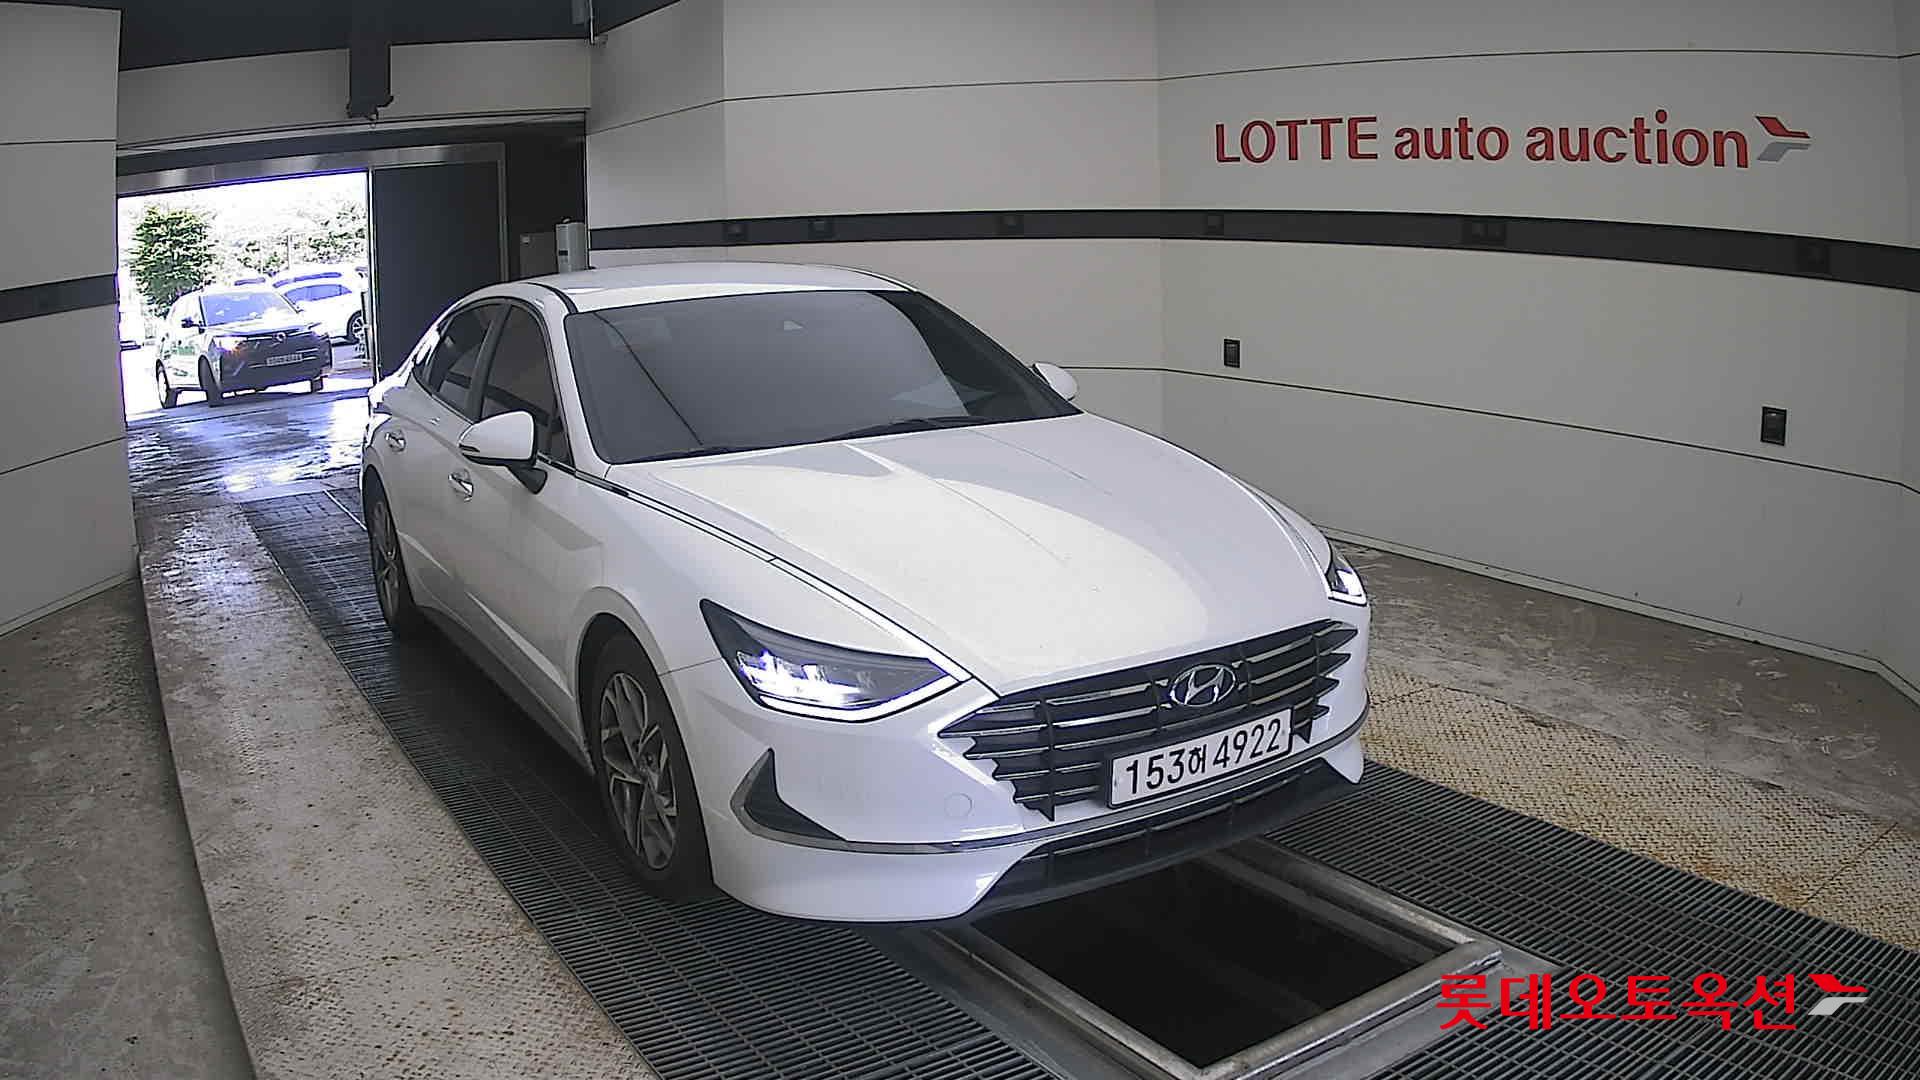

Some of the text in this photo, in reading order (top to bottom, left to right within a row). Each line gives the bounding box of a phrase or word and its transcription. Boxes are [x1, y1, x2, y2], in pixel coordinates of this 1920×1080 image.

[1214, 109, 1750, 169] LOTTE auto auction
